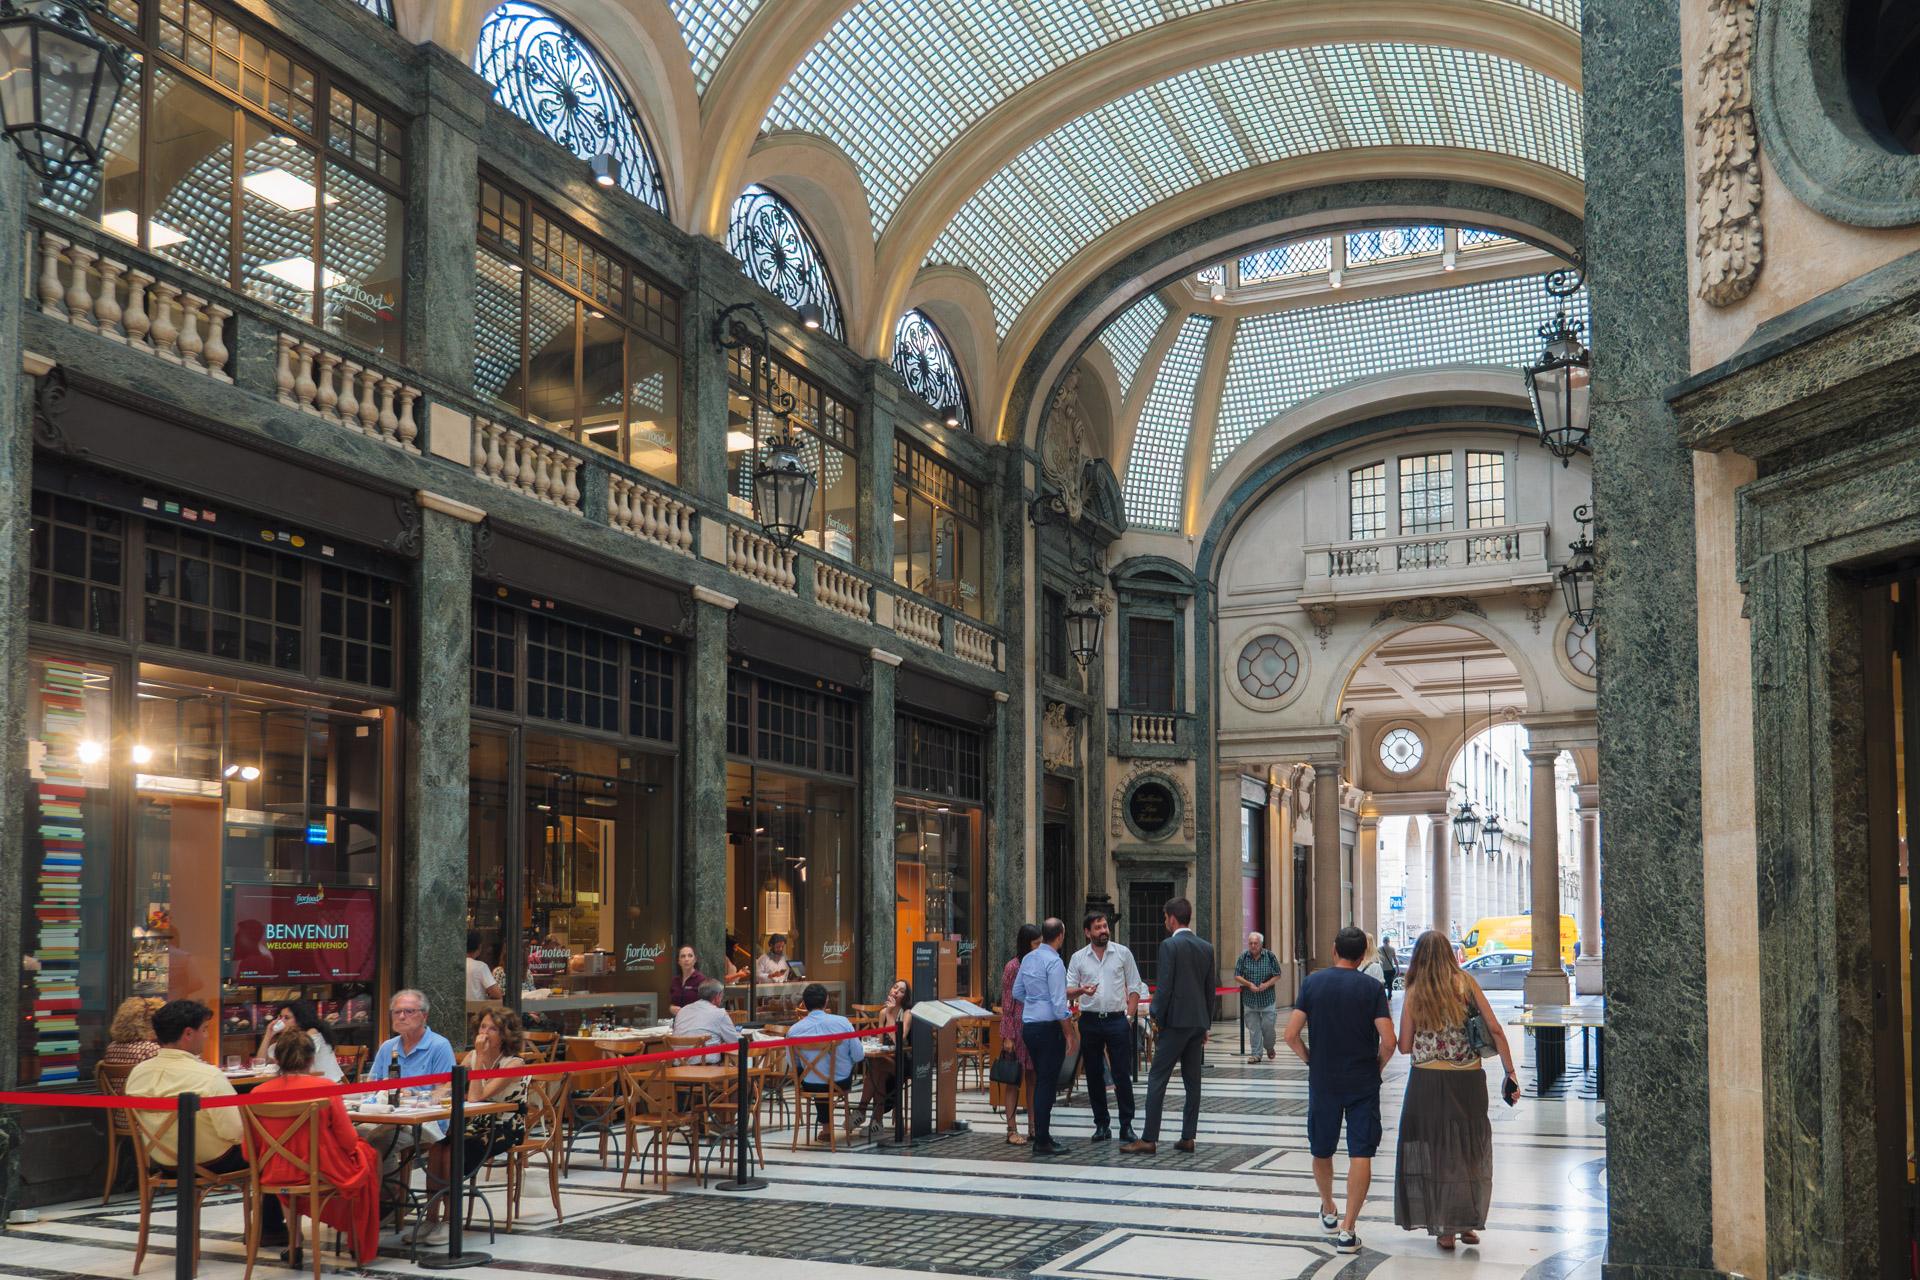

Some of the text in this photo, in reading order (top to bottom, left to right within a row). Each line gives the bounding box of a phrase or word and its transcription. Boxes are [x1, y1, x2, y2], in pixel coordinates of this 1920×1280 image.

[266, 923, 349, 939] BENVENUTI
[266, 942, 349, 950] WELCOME BIENVENIDO
[529, 944, 571, 958] l'Enoteca
[623, 943, 661, 962] fiorfood
